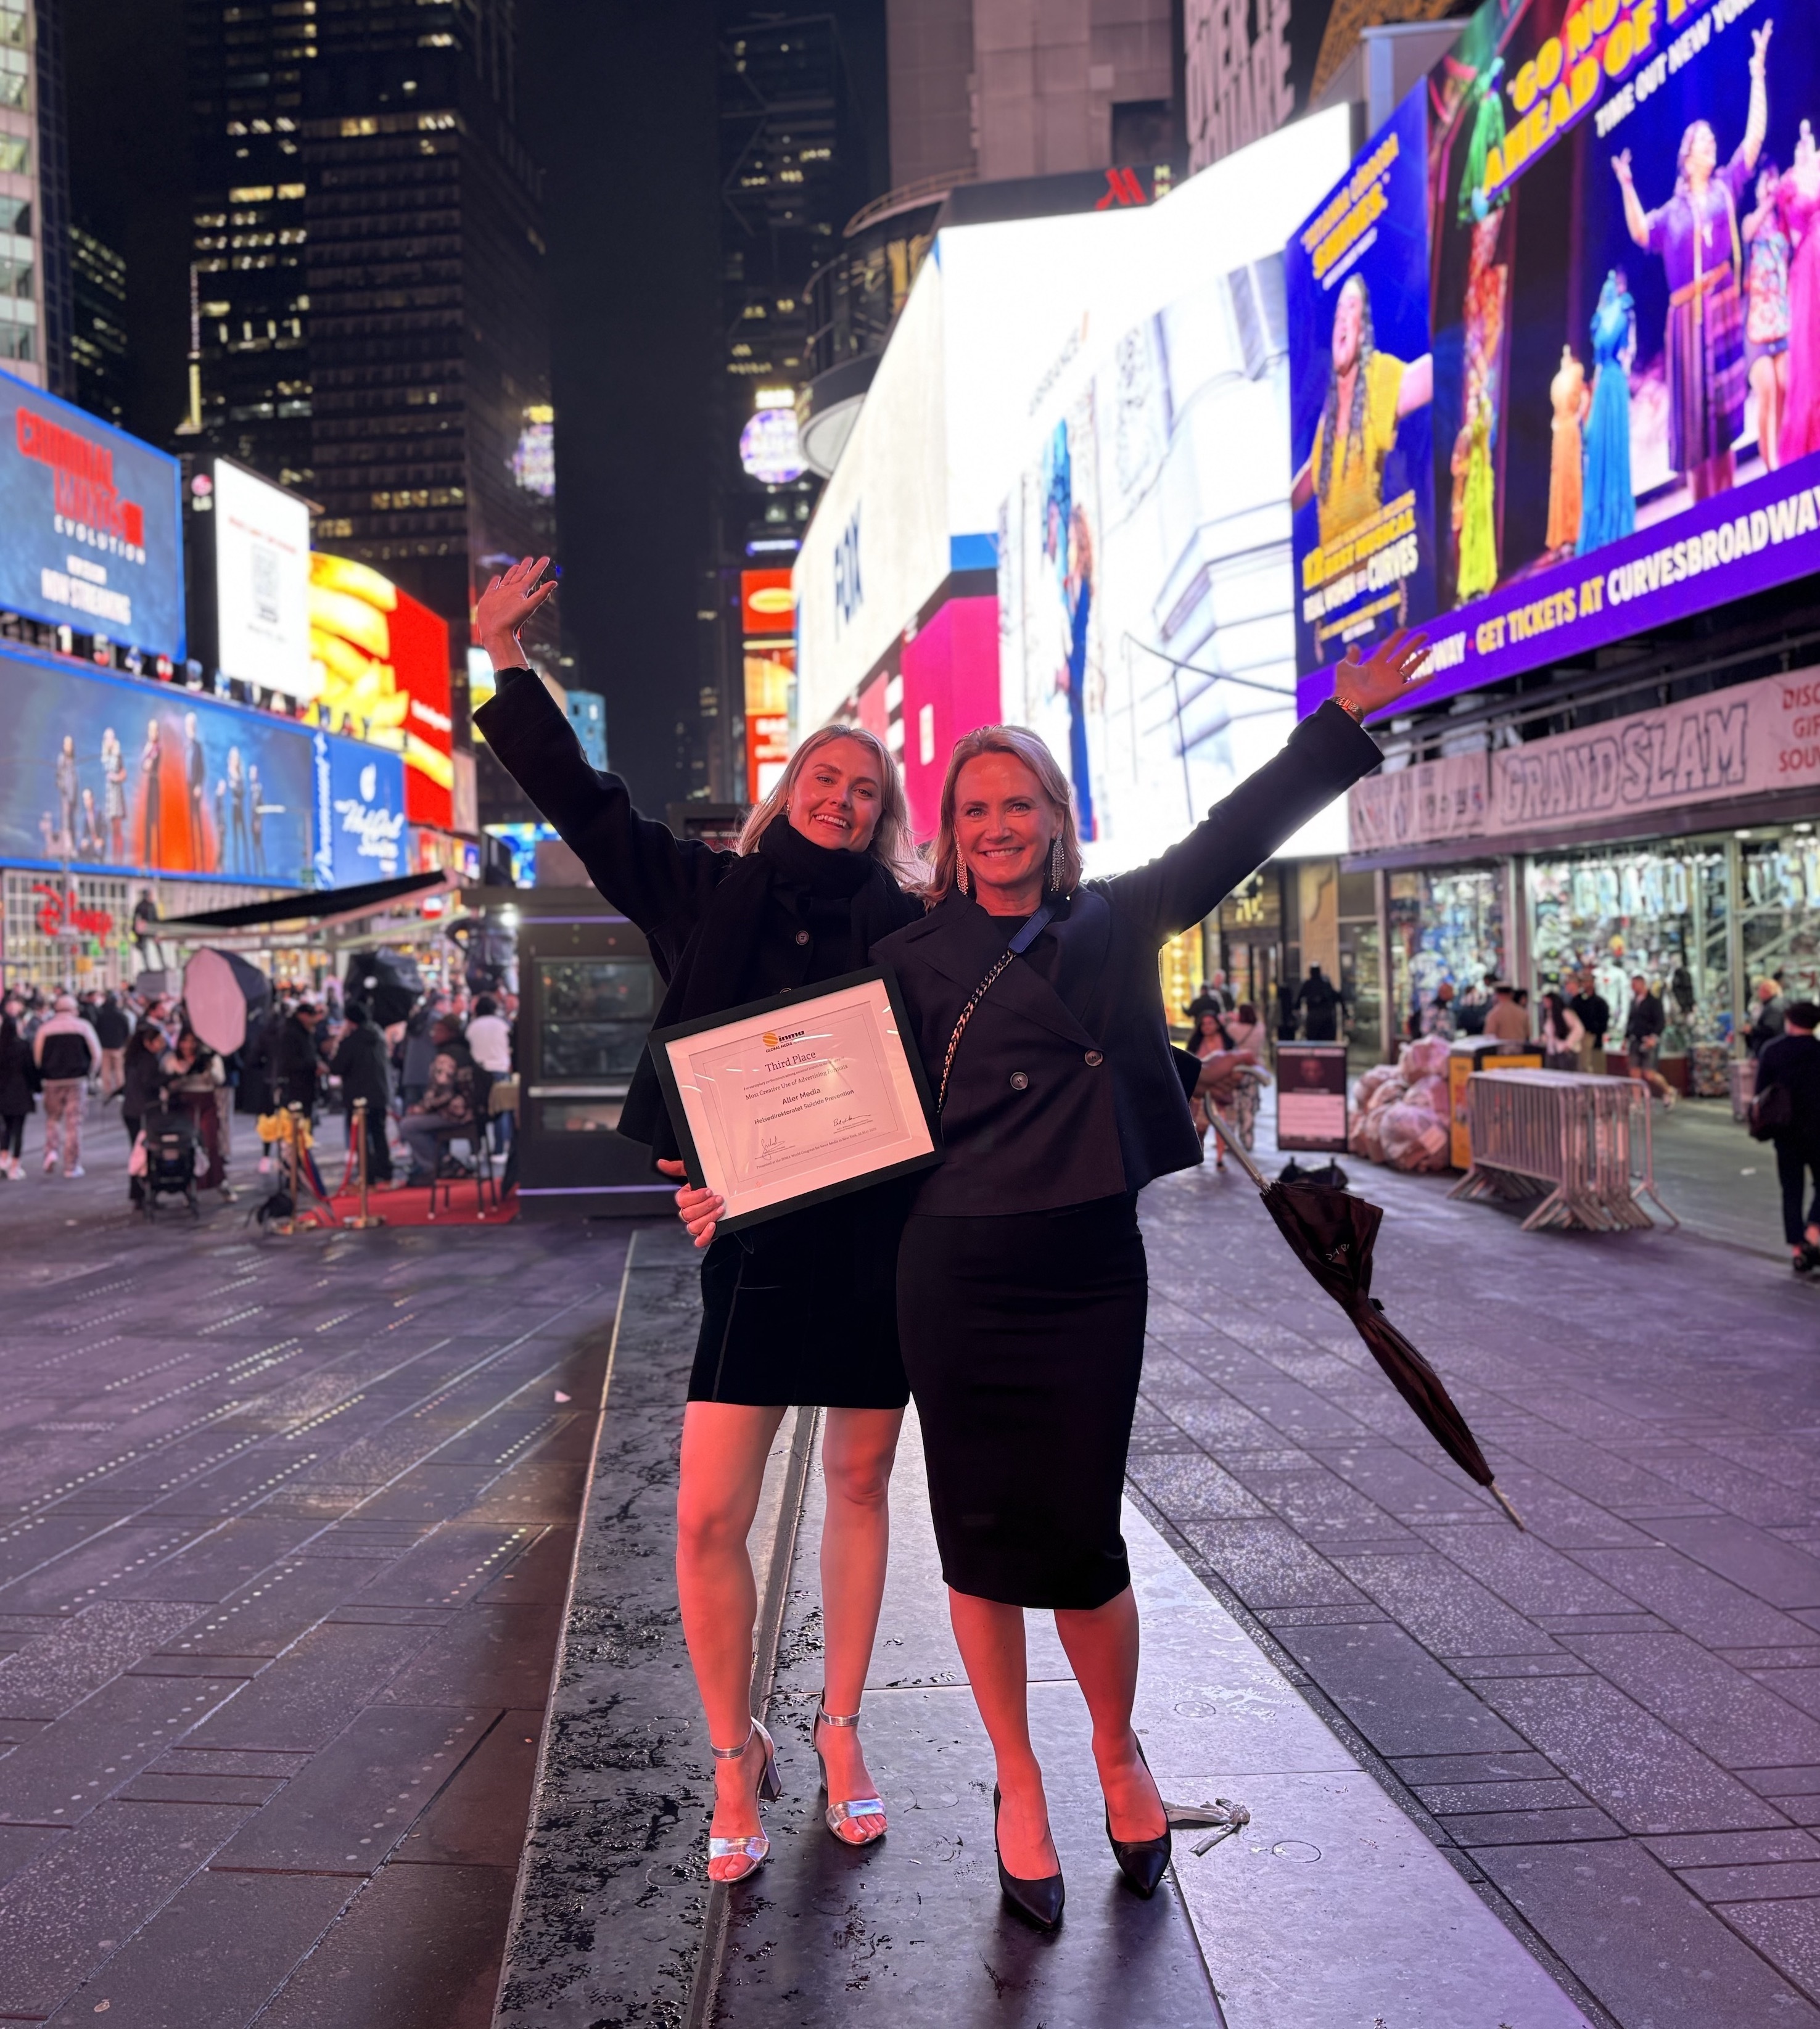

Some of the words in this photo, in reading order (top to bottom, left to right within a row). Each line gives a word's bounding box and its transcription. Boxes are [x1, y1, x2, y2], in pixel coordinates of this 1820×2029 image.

[1635, 52, 1667, 103] OUT
[1668, 12, 1711, 75] NEW
[1483, 57, 1599, 197] AHEAD
[54, 514, 146, 566] EVOLUTION
[1367, 532, 1419, 593] CURVES
[1476, 615, 1505, 655] GET
[1506, 587, 1577, 644] TICKETS
[1579, 575, 1605, 618] AT
[745, 1092, 759, 1100] Most
[759, 1085, 781, 1095] Creative
[798, 1071, 828, 1084] Advertising
[765, 1057, 792, 1072] Third
[792, 1052, 817, 1066] Place
[754, 1105, 803, 1125] Helsedirektoratet
[803, 1099, 824, 1109] Suicide
[824, 1089, 855, 1103] Prevention
[782, 1095, 798, 1105] Aller
[799, 1088, 821, 1099] Media
